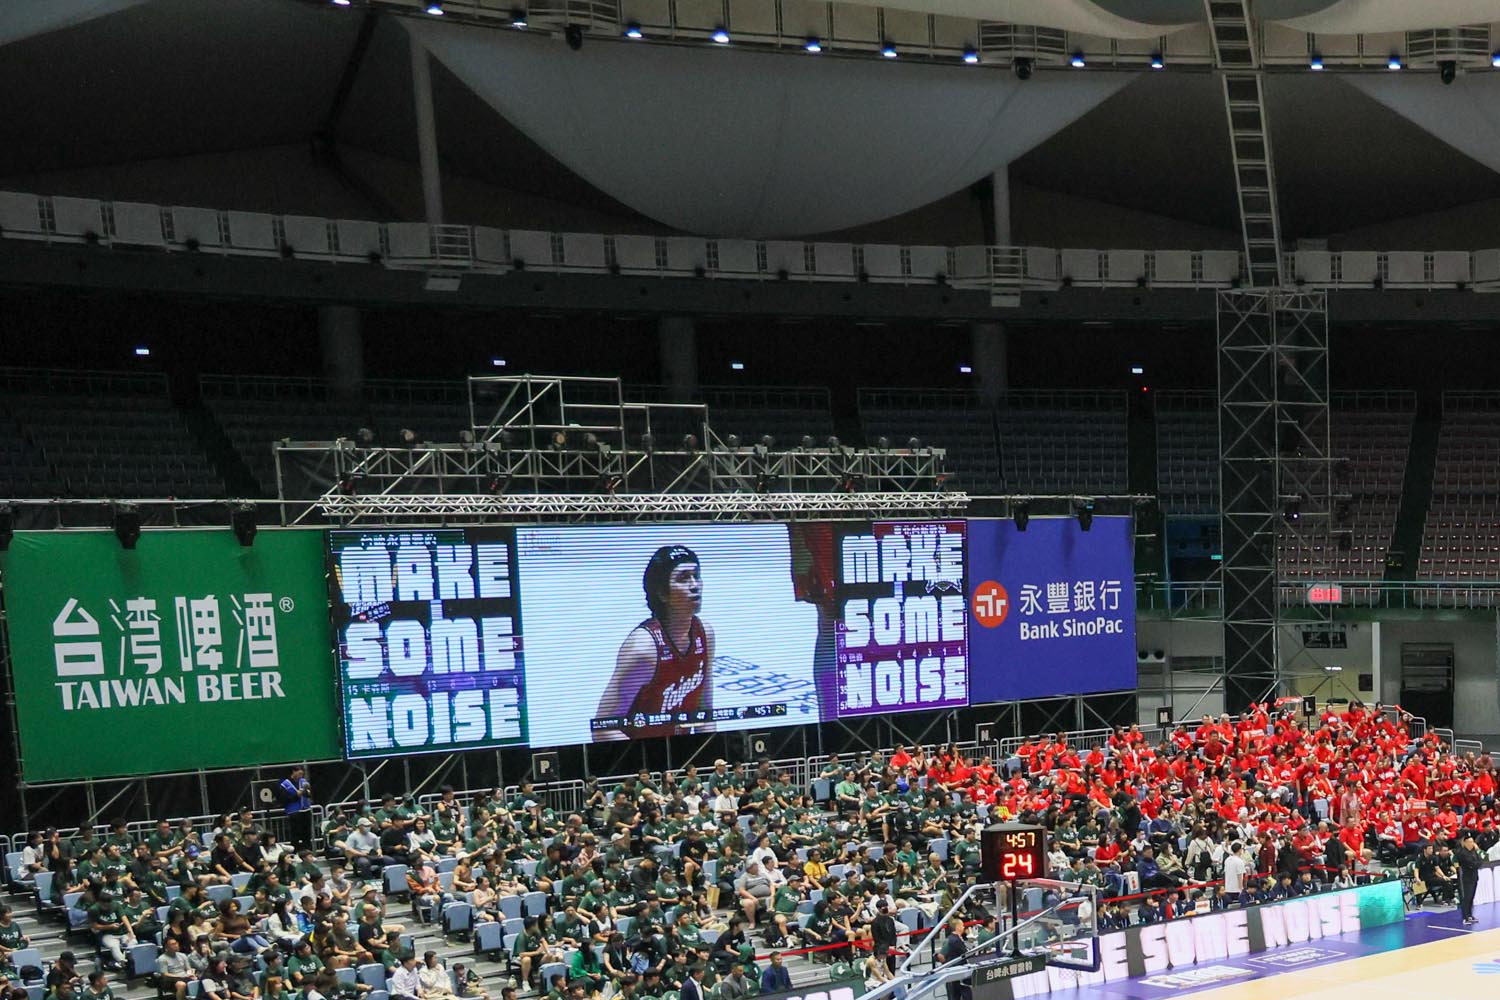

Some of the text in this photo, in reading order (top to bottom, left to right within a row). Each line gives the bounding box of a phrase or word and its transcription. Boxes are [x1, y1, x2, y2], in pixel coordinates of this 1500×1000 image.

[341, 545, 511, 603] MAKE
[842, 534, 963, 584] MAKE
[844, 595, 966, 648] SOME
[1020, 580, 1122, 616] 永豐銀行
[345, 616, 516, 679] SOME
[1020, 617, 1123, 640] Bank SinoPac
[55, 671, 286, 711] TAIWAN BEER
[846, 656, 966, 709] NOISE
[350, 688, 521, 750] NOISE
[1003, 853, 1033, 877] 24
[1006, 832, 1036, 848] 4:57
[1139, 910, 1250, 973] SOME
[1259, 888, 1361, 948] NOISE
